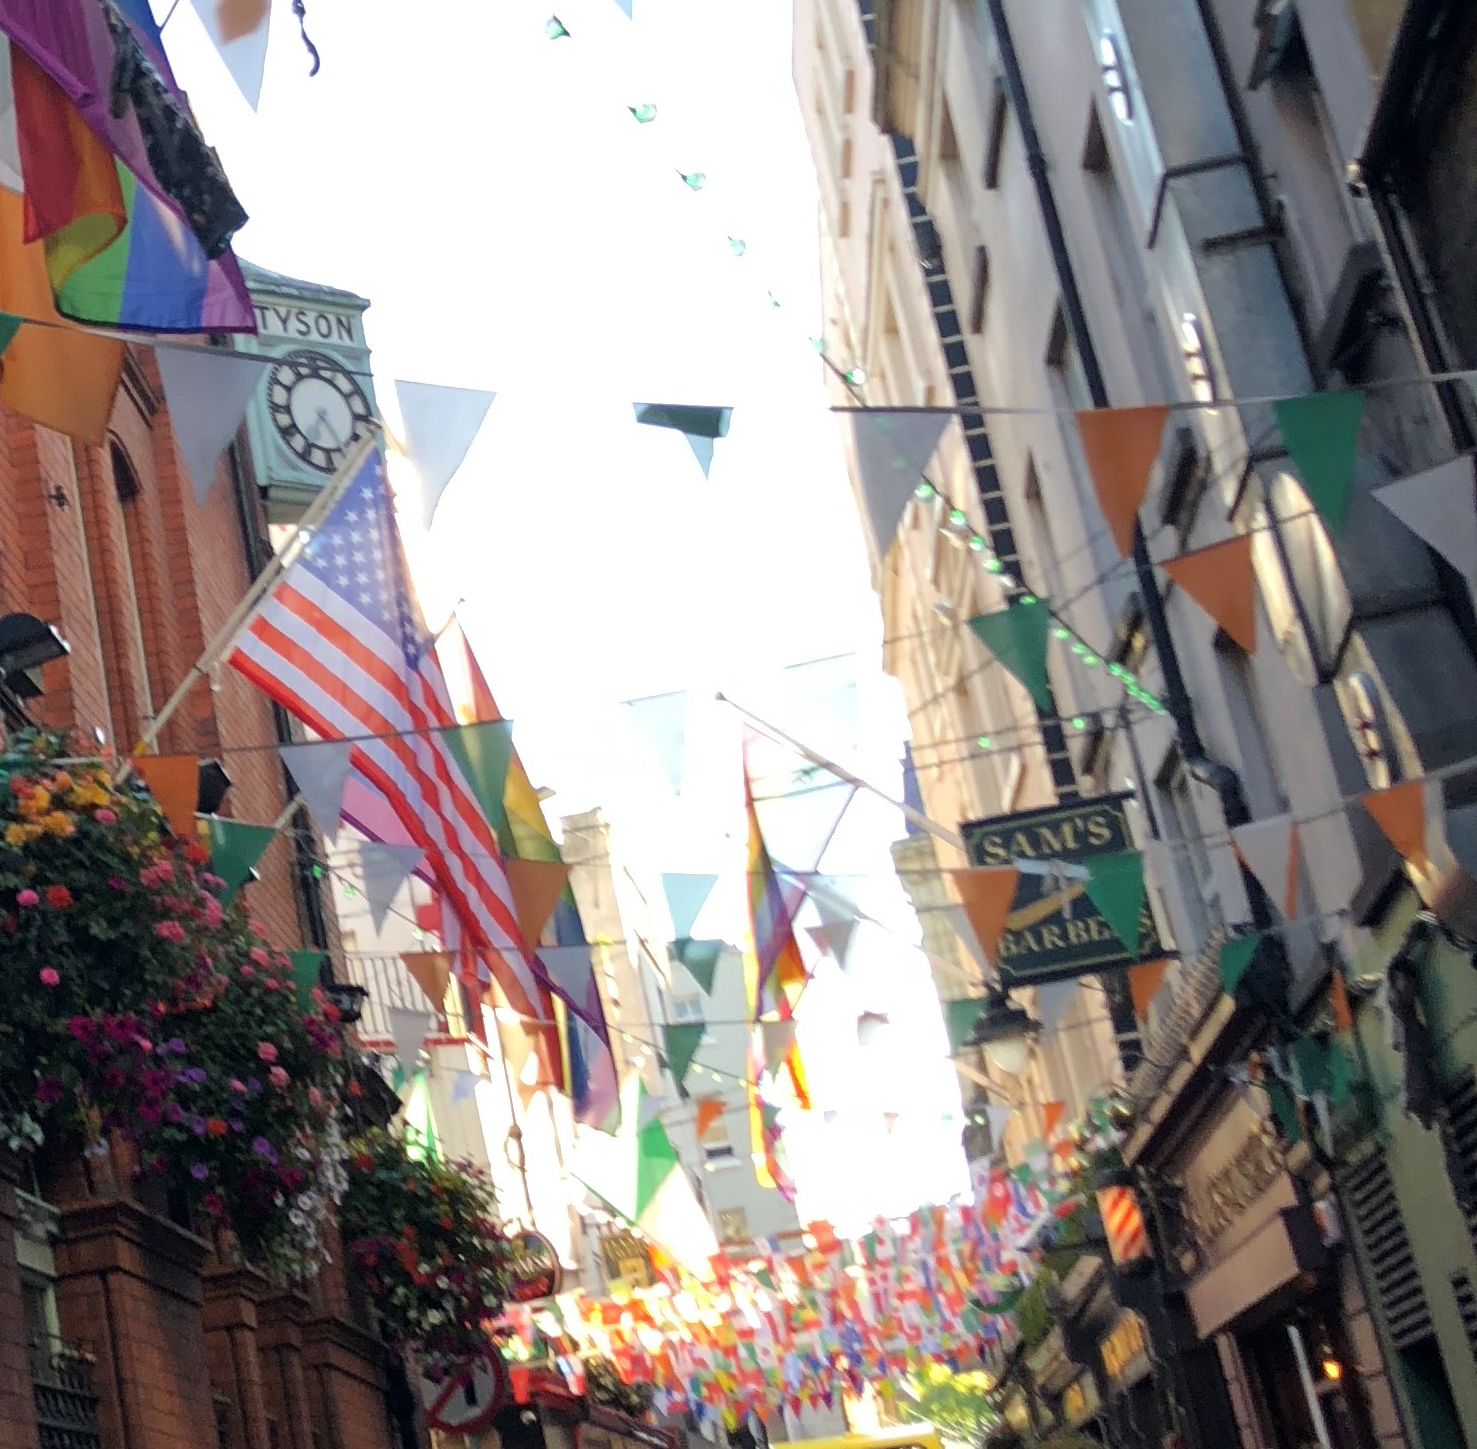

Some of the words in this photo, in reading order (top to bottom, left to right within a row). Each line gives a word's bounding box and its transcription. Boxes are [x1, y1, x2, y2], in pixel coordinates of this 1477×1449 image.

[251, 304, 355, 342] TYSON
[981, 815, 1113, 865] SAM'S
[998, 906, 1152, 957] BARBES
